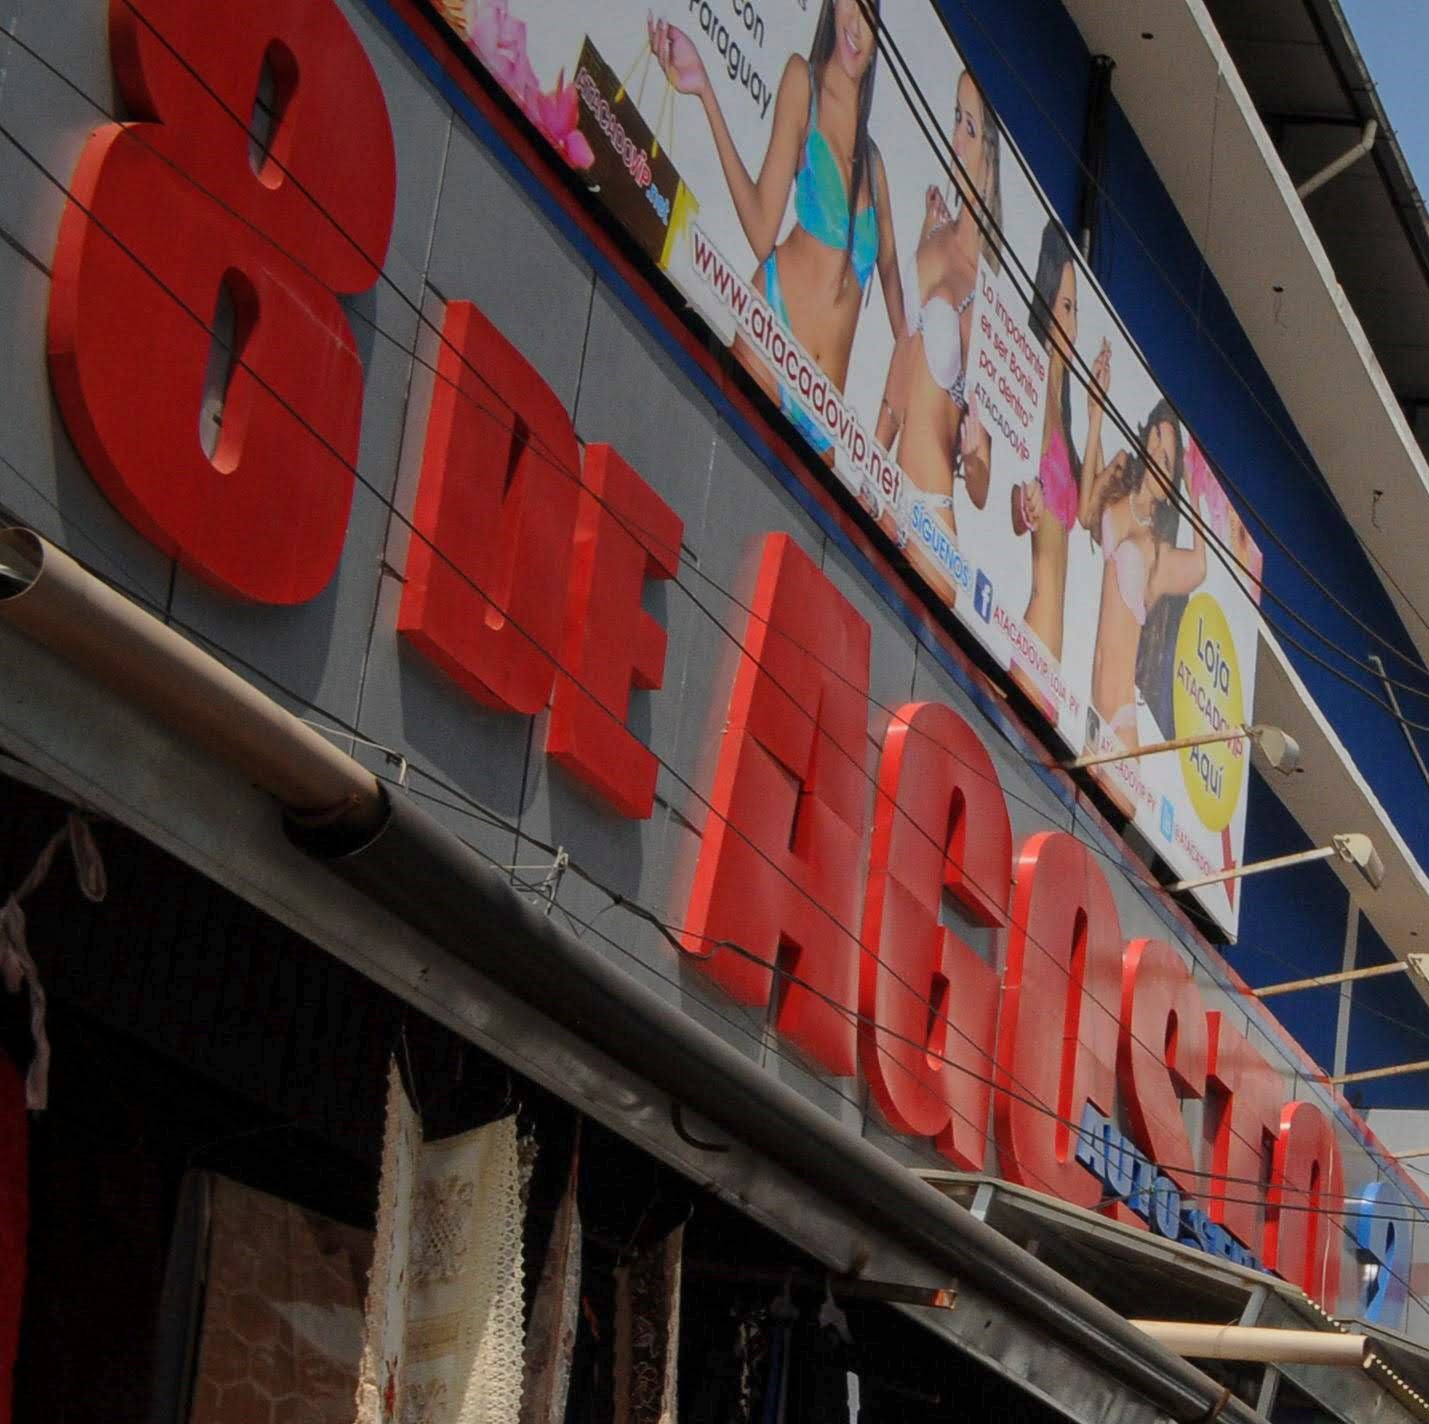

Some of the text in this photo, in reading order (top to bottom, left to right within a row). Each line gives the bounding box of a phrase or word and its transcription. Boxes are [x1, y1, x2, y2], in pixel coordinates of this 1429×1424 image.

[693, 234, 901, 504] www.atacadovip.net
[48, 0, 1346, 1322] 8 DE AGOSTO
[1196, 617, 1230, 697] Loja
